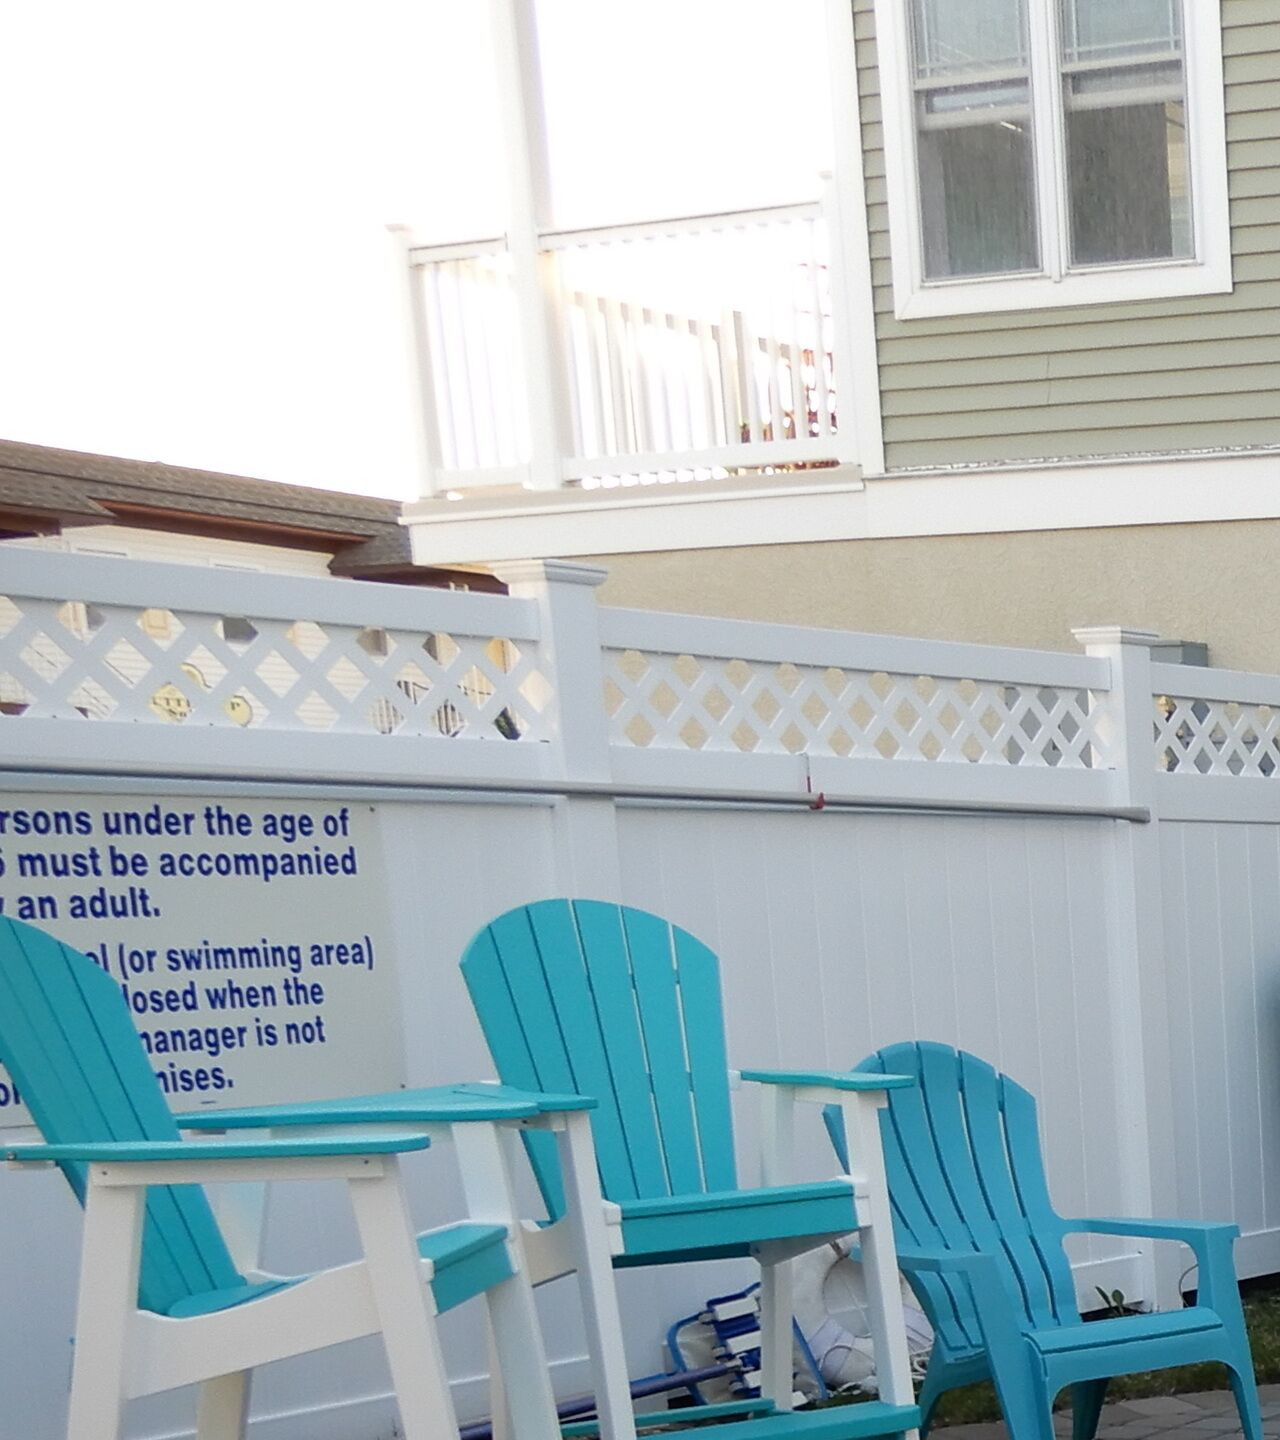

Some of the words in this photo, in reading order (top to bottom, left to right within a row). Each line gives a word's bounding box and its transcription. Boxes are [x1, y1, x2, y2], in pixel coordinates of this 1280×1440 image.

[103, 805, 196, 836] under
[204, 805, 253, 837] the
[262, 813, 314, 843] age
[323, 807, 350, 837] of
[18, 846, 102, 877] must
[108, 845, 149, 877] be
[160, 846, 358, 882] accompanied
[18, 895, 58, 920] an
[69, 886, 161, 919] adult.
[119, 942, 157, 981] (or
[166, 938, 302, 974] swimming
[310, 935, 374, 971] area)
[121, 980, 199, 1015] losed
[205, 978, 278, 1011] when
[283, 976, 325, 1007] the
[254, 1017, 279, 1047] is
[285, 1015, 326, 1045] not
